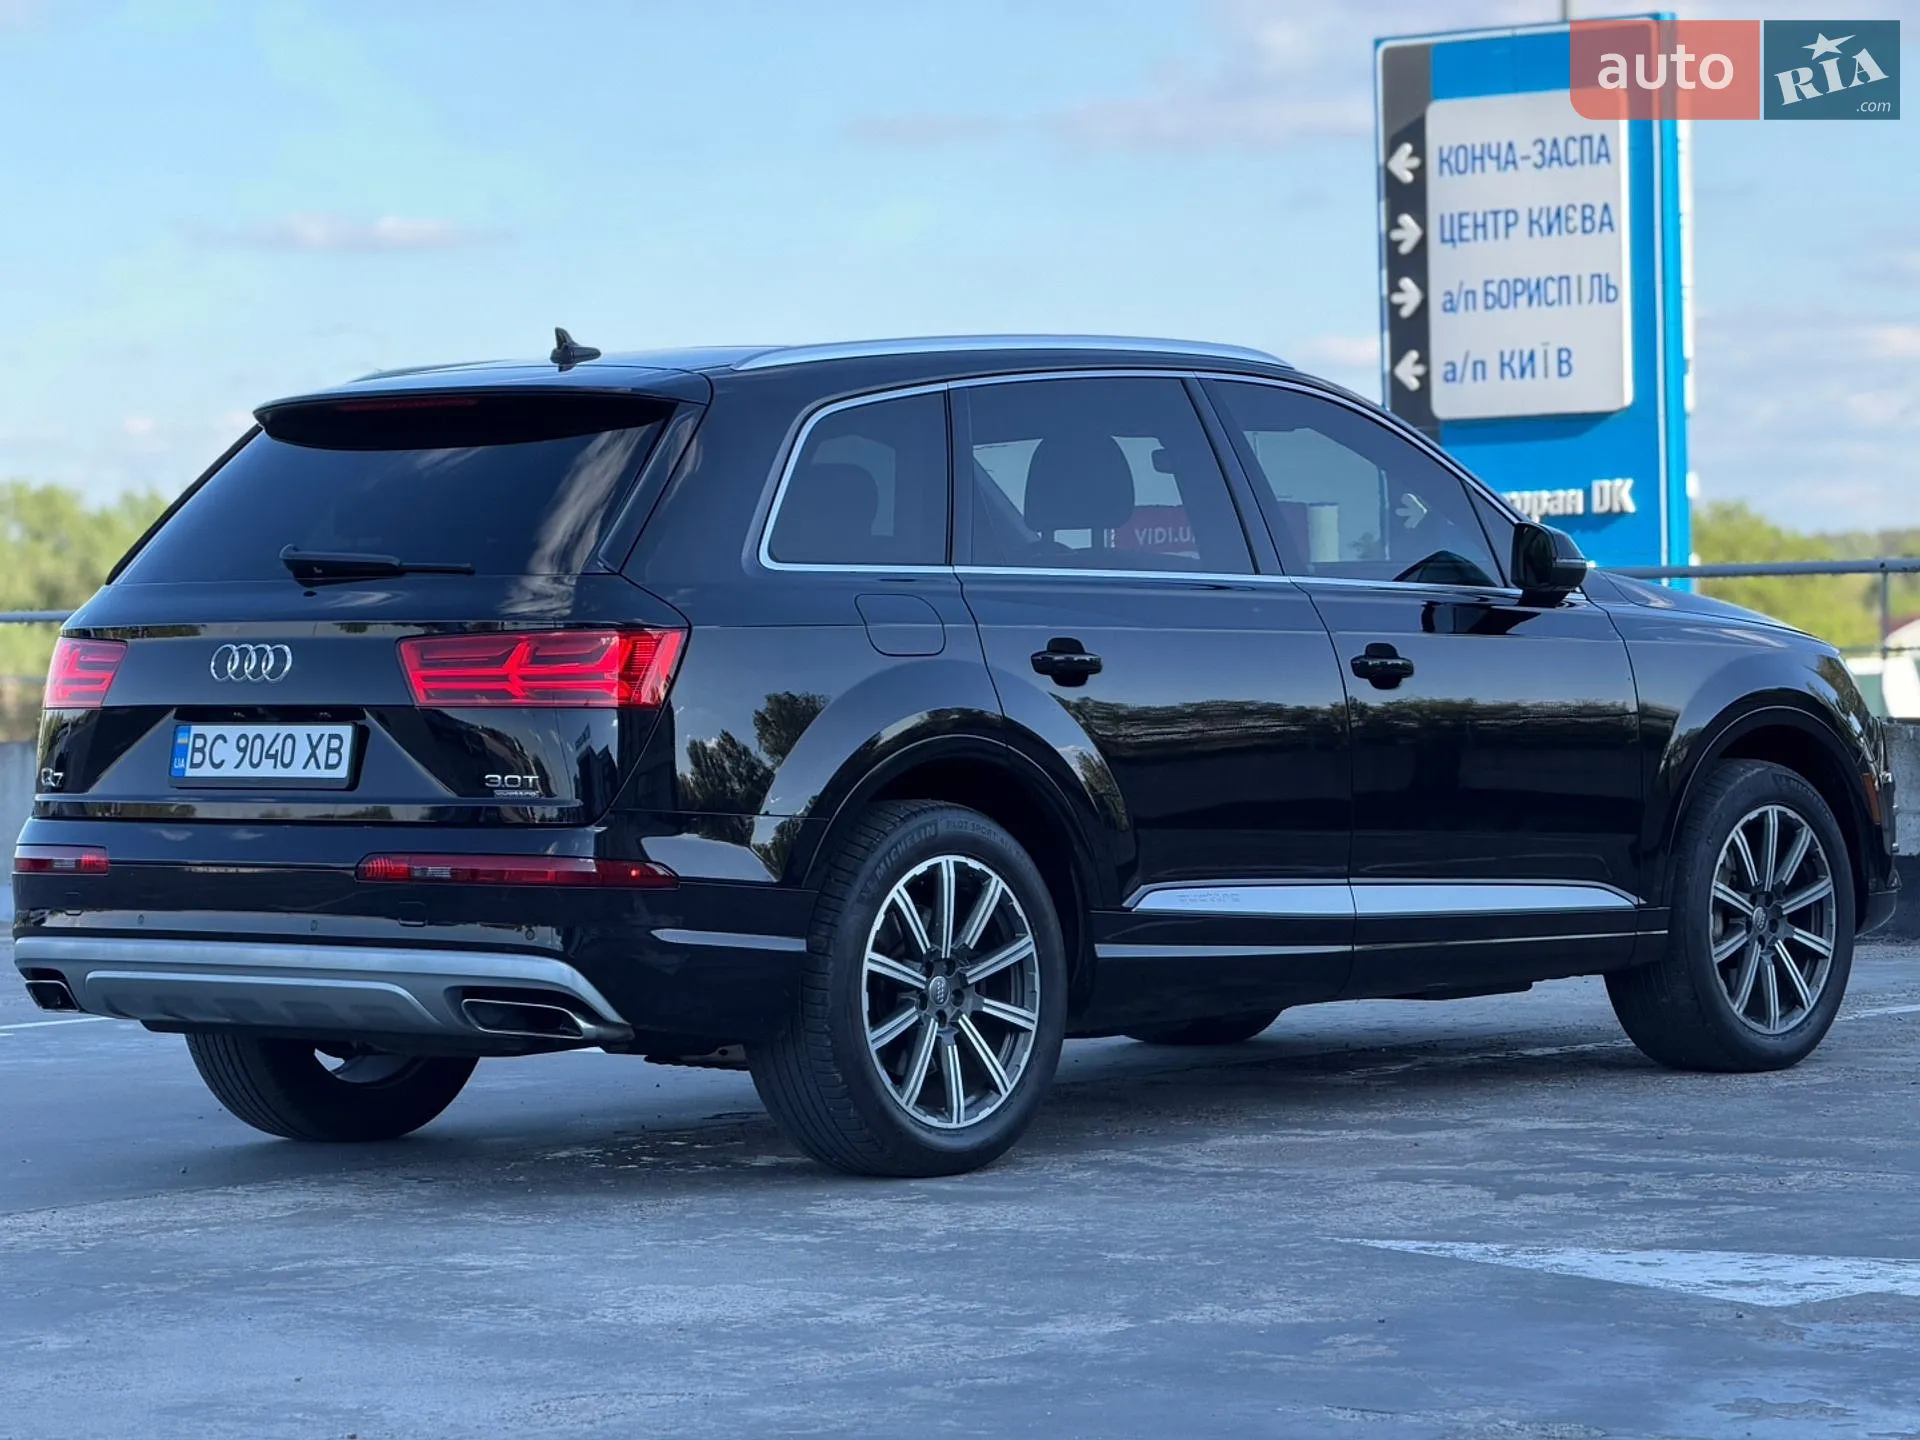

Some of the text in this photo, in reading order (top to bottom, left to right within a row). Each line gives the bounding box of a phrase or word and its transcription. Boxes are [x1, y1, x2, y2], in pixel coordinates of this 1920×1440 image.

[1438, 133, 1612, 177] КОНЧА-ЗАСПА
[1439, 202, 1615, 249] ЦЕНТР КИЄВА
[1441, 272, 1619, 314] а/п БОРИСПІЛЬ
[1443, 341, 1574, 384] а/п КИЇВ
[1591, 477, 1636, 514] DK
[189, 733, 228, 770] BC
[233, 733, 297, 770] 9040
[302, 733, 344, 770] XB
[41, 767, 64, 788] Q7
[874, 822, 938, 878] MICHELIN
